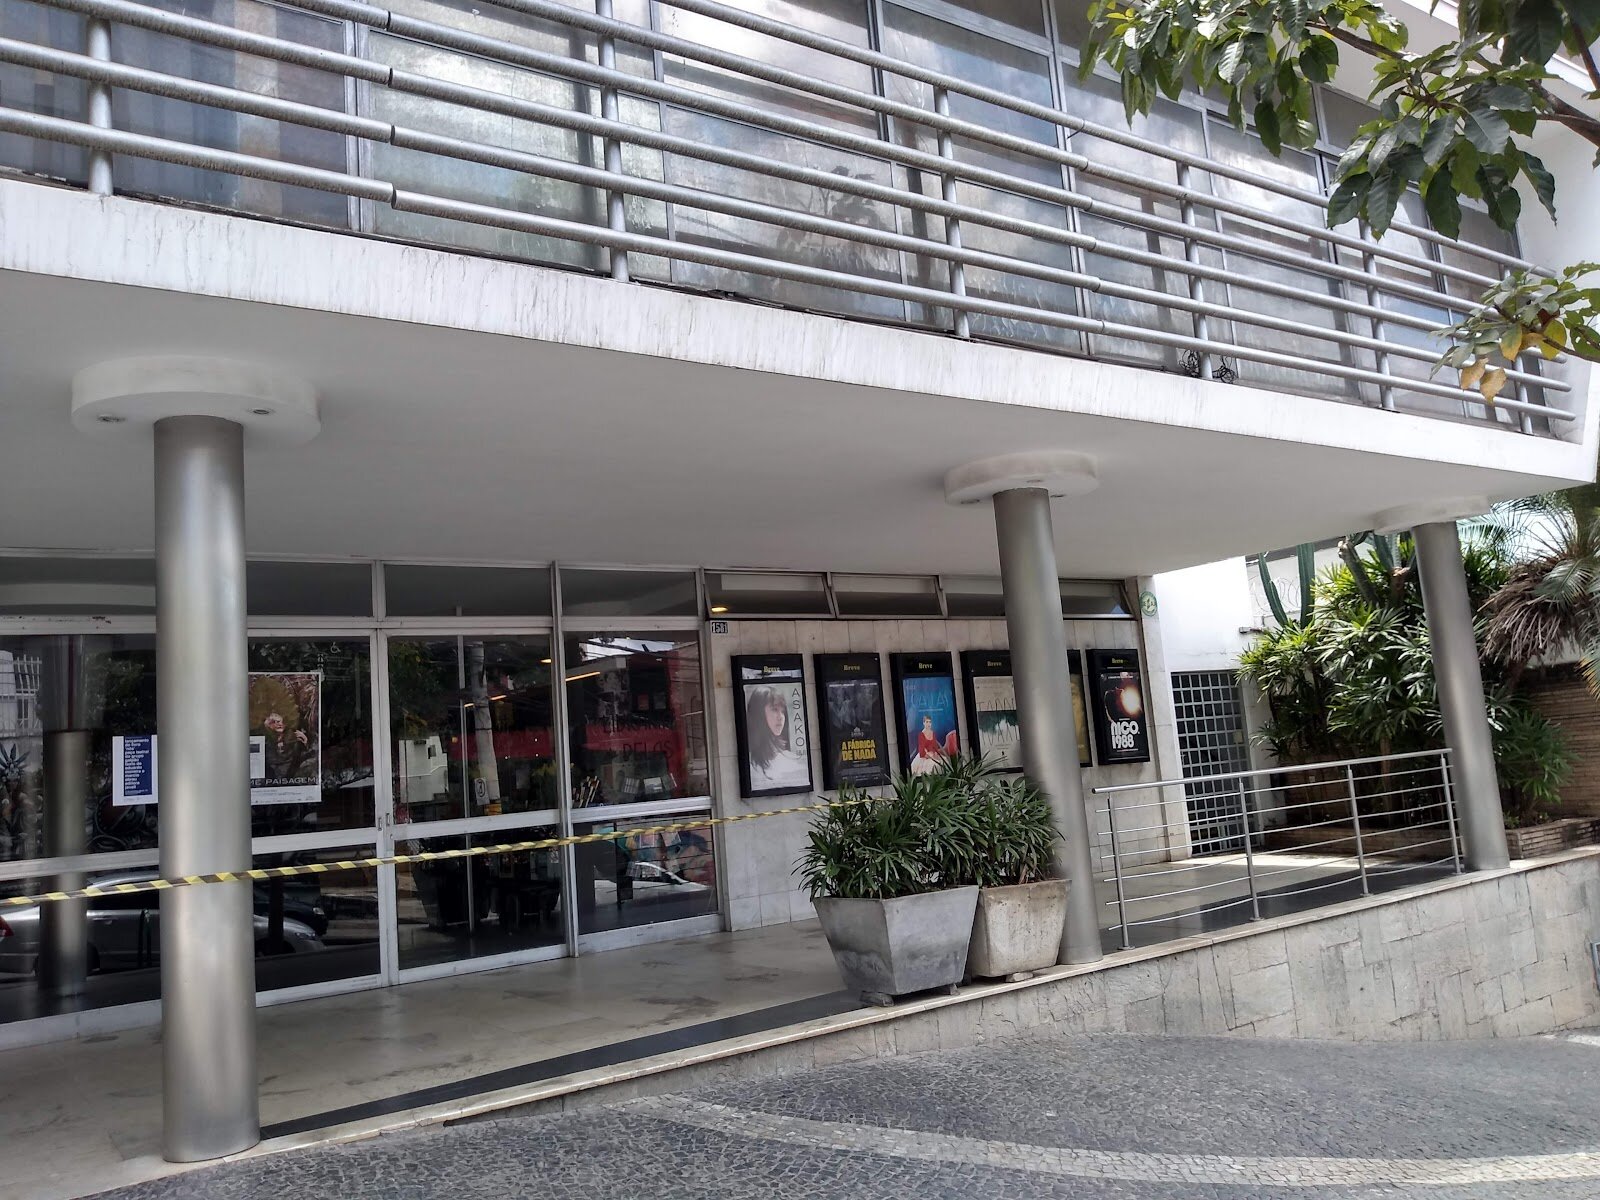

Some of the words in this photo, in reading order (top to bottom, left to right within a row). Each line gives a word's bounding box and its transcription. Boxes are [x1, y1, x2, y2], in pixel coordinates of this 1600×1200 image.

[791, 687, 805, 747] ASAKO
[842, 741, 847, 751] A
[847, 739, 876, 750] FÁBRICA
[1111, 734, 1135, 749] 1988
[842, 750, 853, 761] DE
[854, 748, 877, 760] NADA
[265, 776, 316, 785] PAISAGEM
